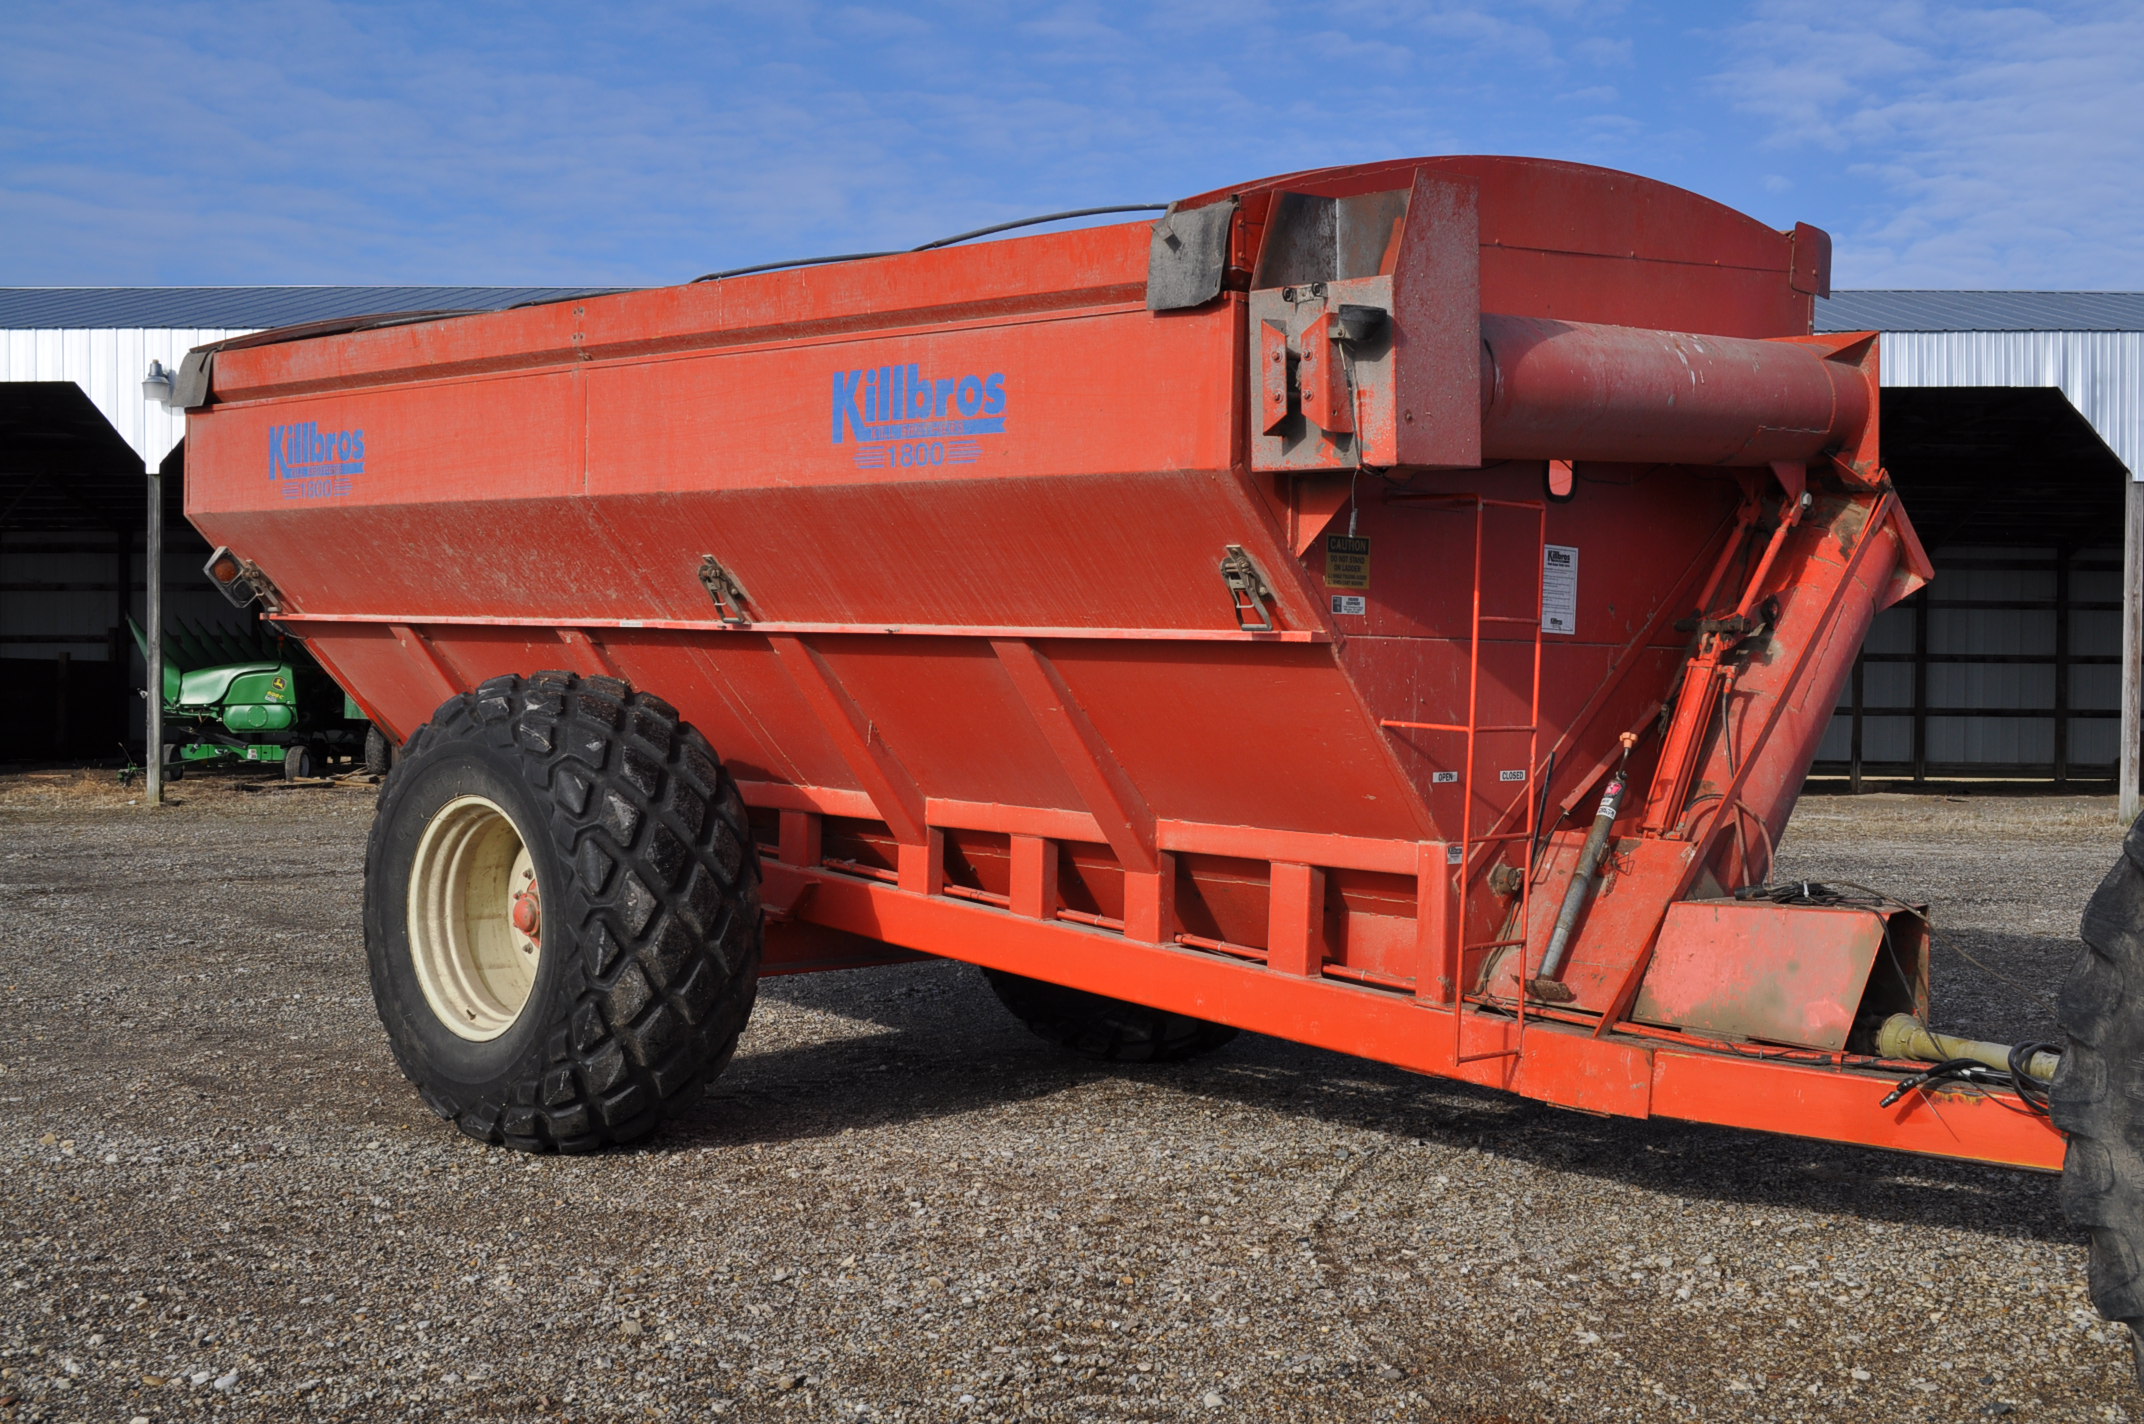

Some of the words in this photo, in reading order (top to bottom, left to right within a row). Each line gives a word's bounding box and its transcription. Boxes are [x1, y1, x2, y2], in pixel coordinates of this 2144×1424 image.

[832, 363, 1007, 444] Killbros
[269, 421, 365, 481] Killbros
[887, 442, 945, 468] 1800
[301, 479, 333, 498] 1800
[1329, 537, 1367, 553] CAUTION
[1438, 772, 1454, 781] OPEN
[1502, 771, 1524, 780] CLOSED
